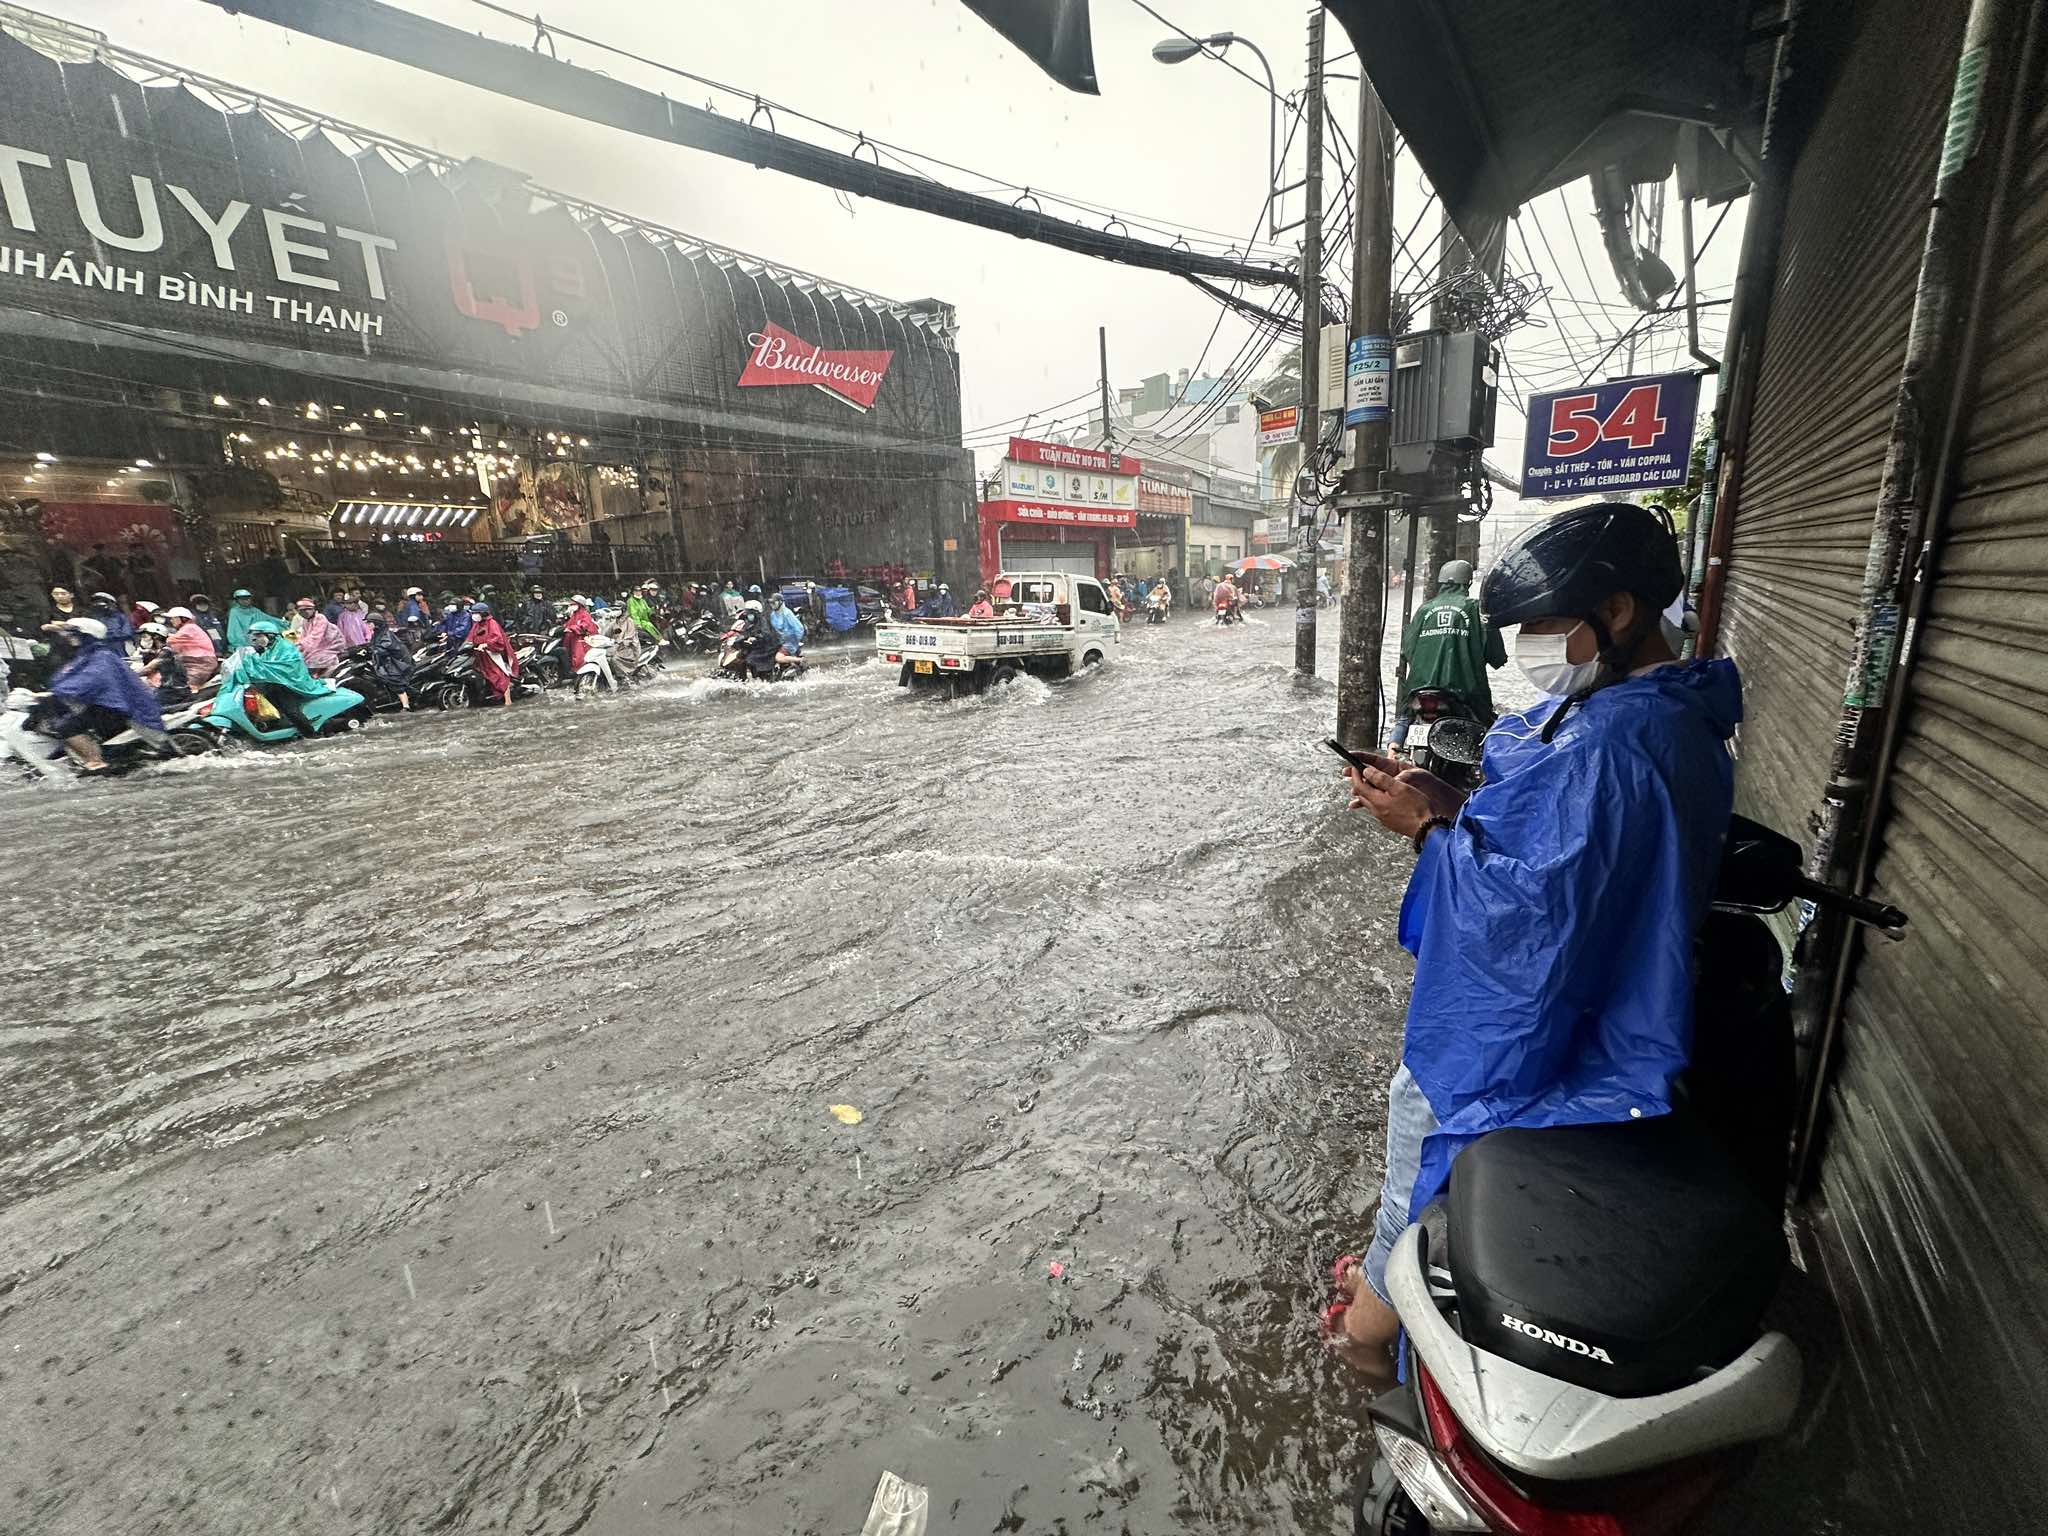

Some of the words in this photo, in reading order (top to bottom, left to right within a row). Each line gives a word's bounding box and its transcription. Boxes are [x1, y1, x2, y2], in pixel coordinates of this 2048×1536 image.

[0, 143, 398, 301] TUYẾT
[159, 271, 254, 313] BÌNH
[267, 295, 384, 336] THẠNH
[747, 332, 883, 385] Budweiser
[1353, 360, 1382, 372] F25/2
[1547, 384, 1667, 457] 54
[1567, 478, 1573, 488] V
[1597, 472, 1641, 486] CEMBOARD
[1642, 469, 1660, 483] CÁC
[1662, 469, 1681, 482] LOẠI
[1570, 461, 1590, 473] THÉP
[1597, 458, 1612, 470] TÔN
[1620, 456, 1636, 469] VÁN
[1638, 453, 1672, 466] COPPHA
[1500, 1313, 1615, 1365] HONDA
